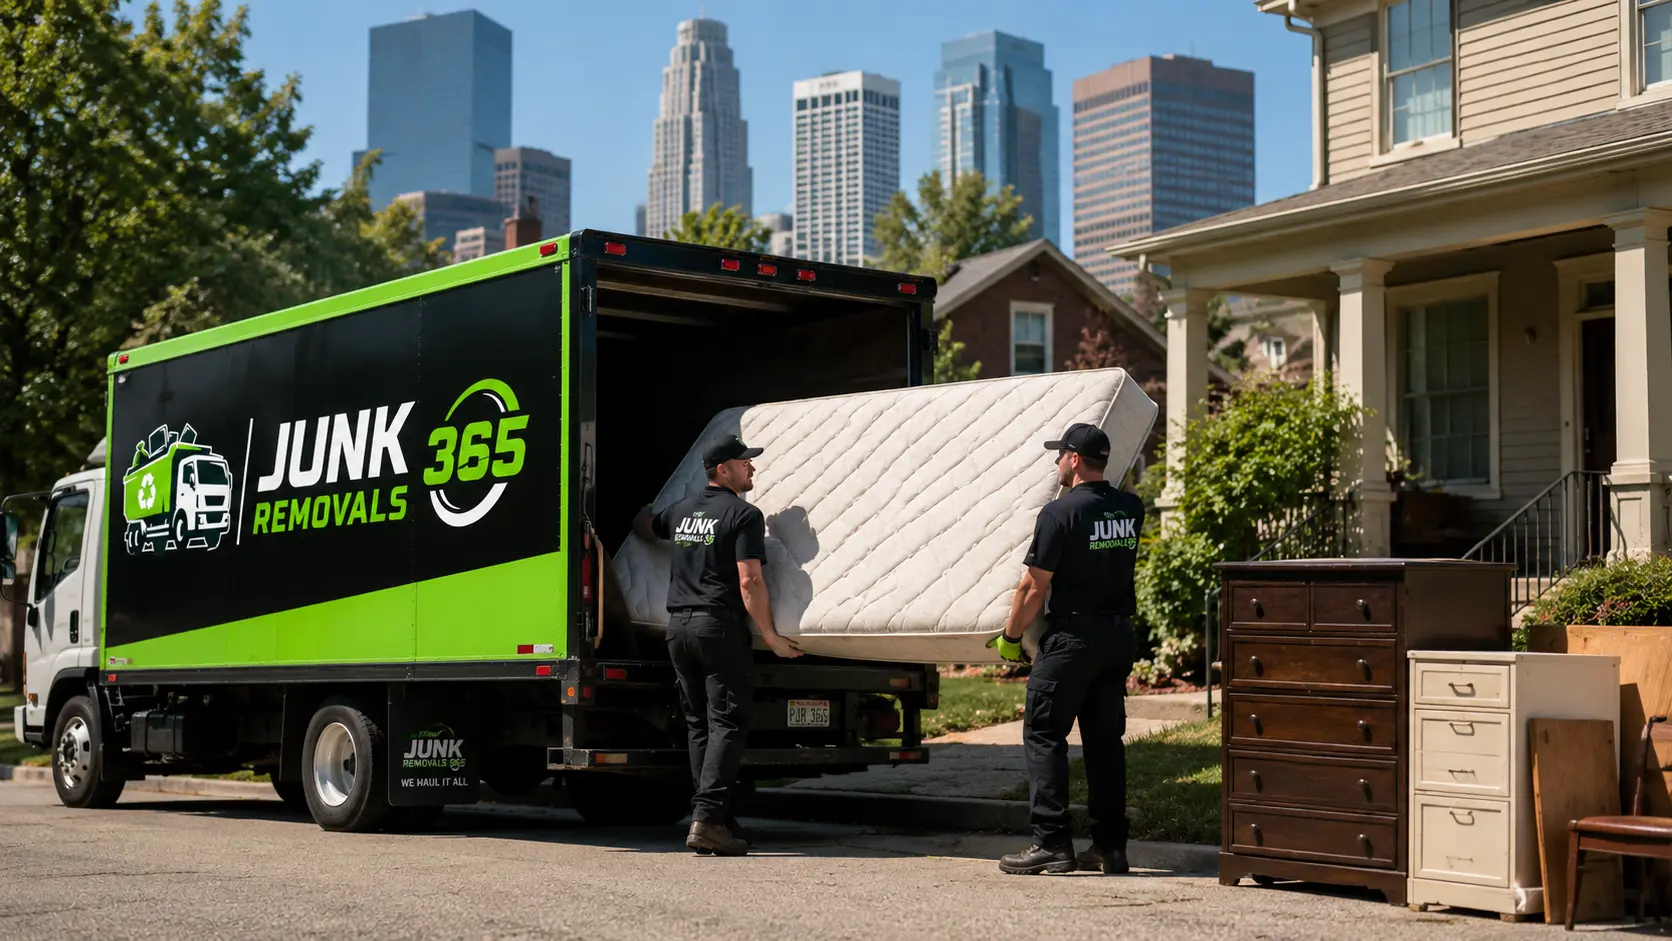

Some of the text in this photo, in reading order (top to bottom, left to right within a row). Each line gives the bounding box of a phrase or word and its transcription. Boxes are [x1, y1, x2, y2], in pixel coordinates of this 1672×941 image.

[258, 401, 415, 492] JUNK
[422, 414, 530, 486] 365
[252, 485, 409, 535] REMOVALS
[675, 517, 720, 535] JUNK
[1089, 518, 1136, 541] JUNK
[403, 739, 464, 758] JUNK
[402, 759, 447, 768] REMOVALS
[401, 777, 469, 787] WE HAUL IT ALL
